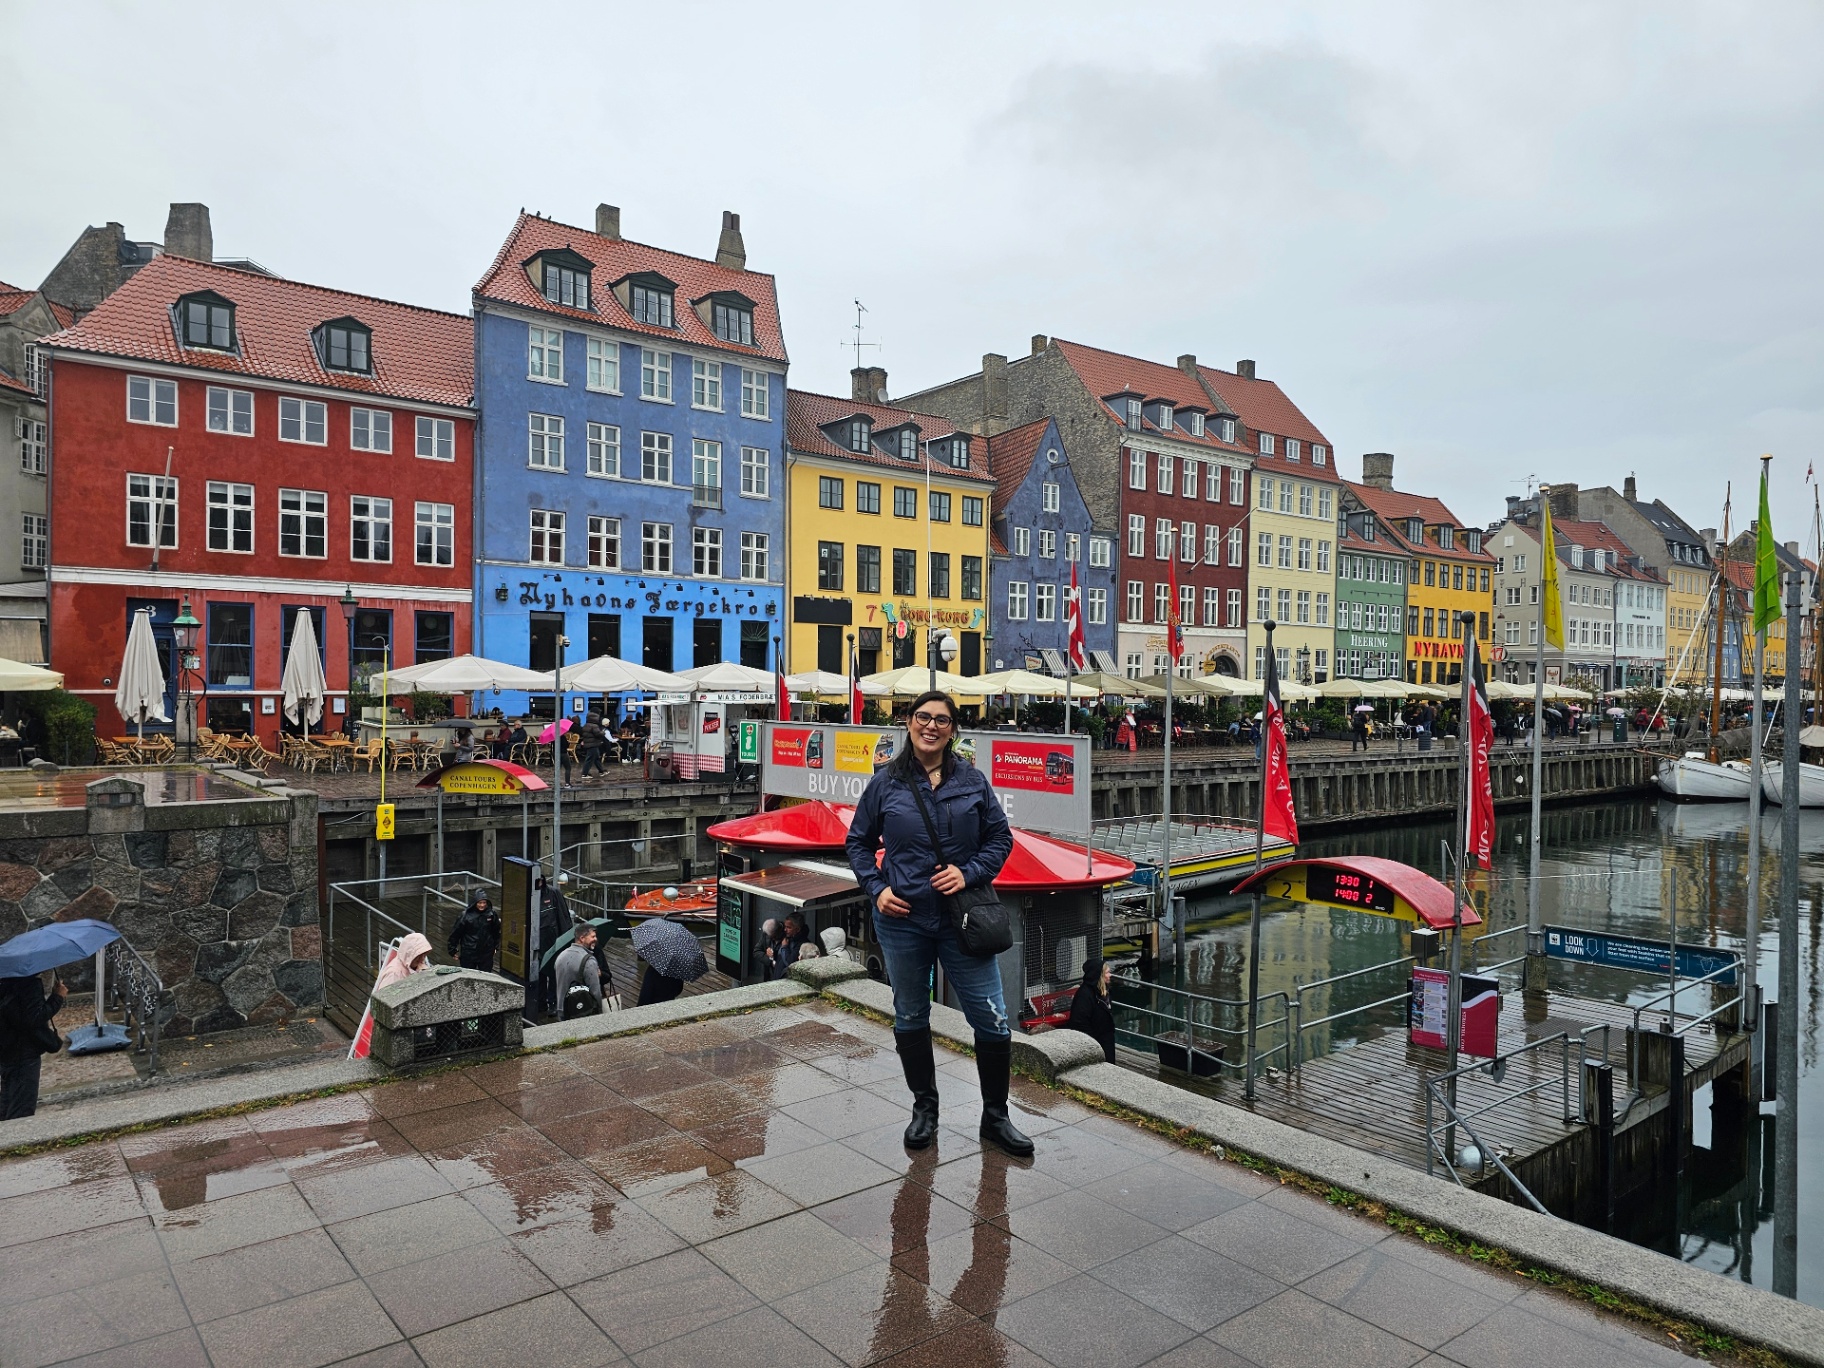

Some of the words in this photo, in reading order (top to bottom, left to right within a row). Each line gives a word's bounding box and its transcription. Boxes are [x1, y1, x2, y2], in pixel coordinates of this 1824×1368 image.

[866, 604, 878, 623] 7
[1351, 634, 1389, 648] HEERING
[1414, 641, 1464, 659] NYHAVN
[1491, 647, 1503, 661] 17
[1004, 755, 1043, 766] PANORAMA
[449, 774, 473, 782] CANAL
[474, 775, 496, 783] TOURS
[808, 772, 839, 796] BUY
[449, 782, 497, 790] COPENHAGEN
[1281, 881, 1293, 900] 2
[1365, 893, 1373, 904] 2
[1564, 934, 1584, 947] LOOK
[1564, 945, 1585, 956] DOWN
